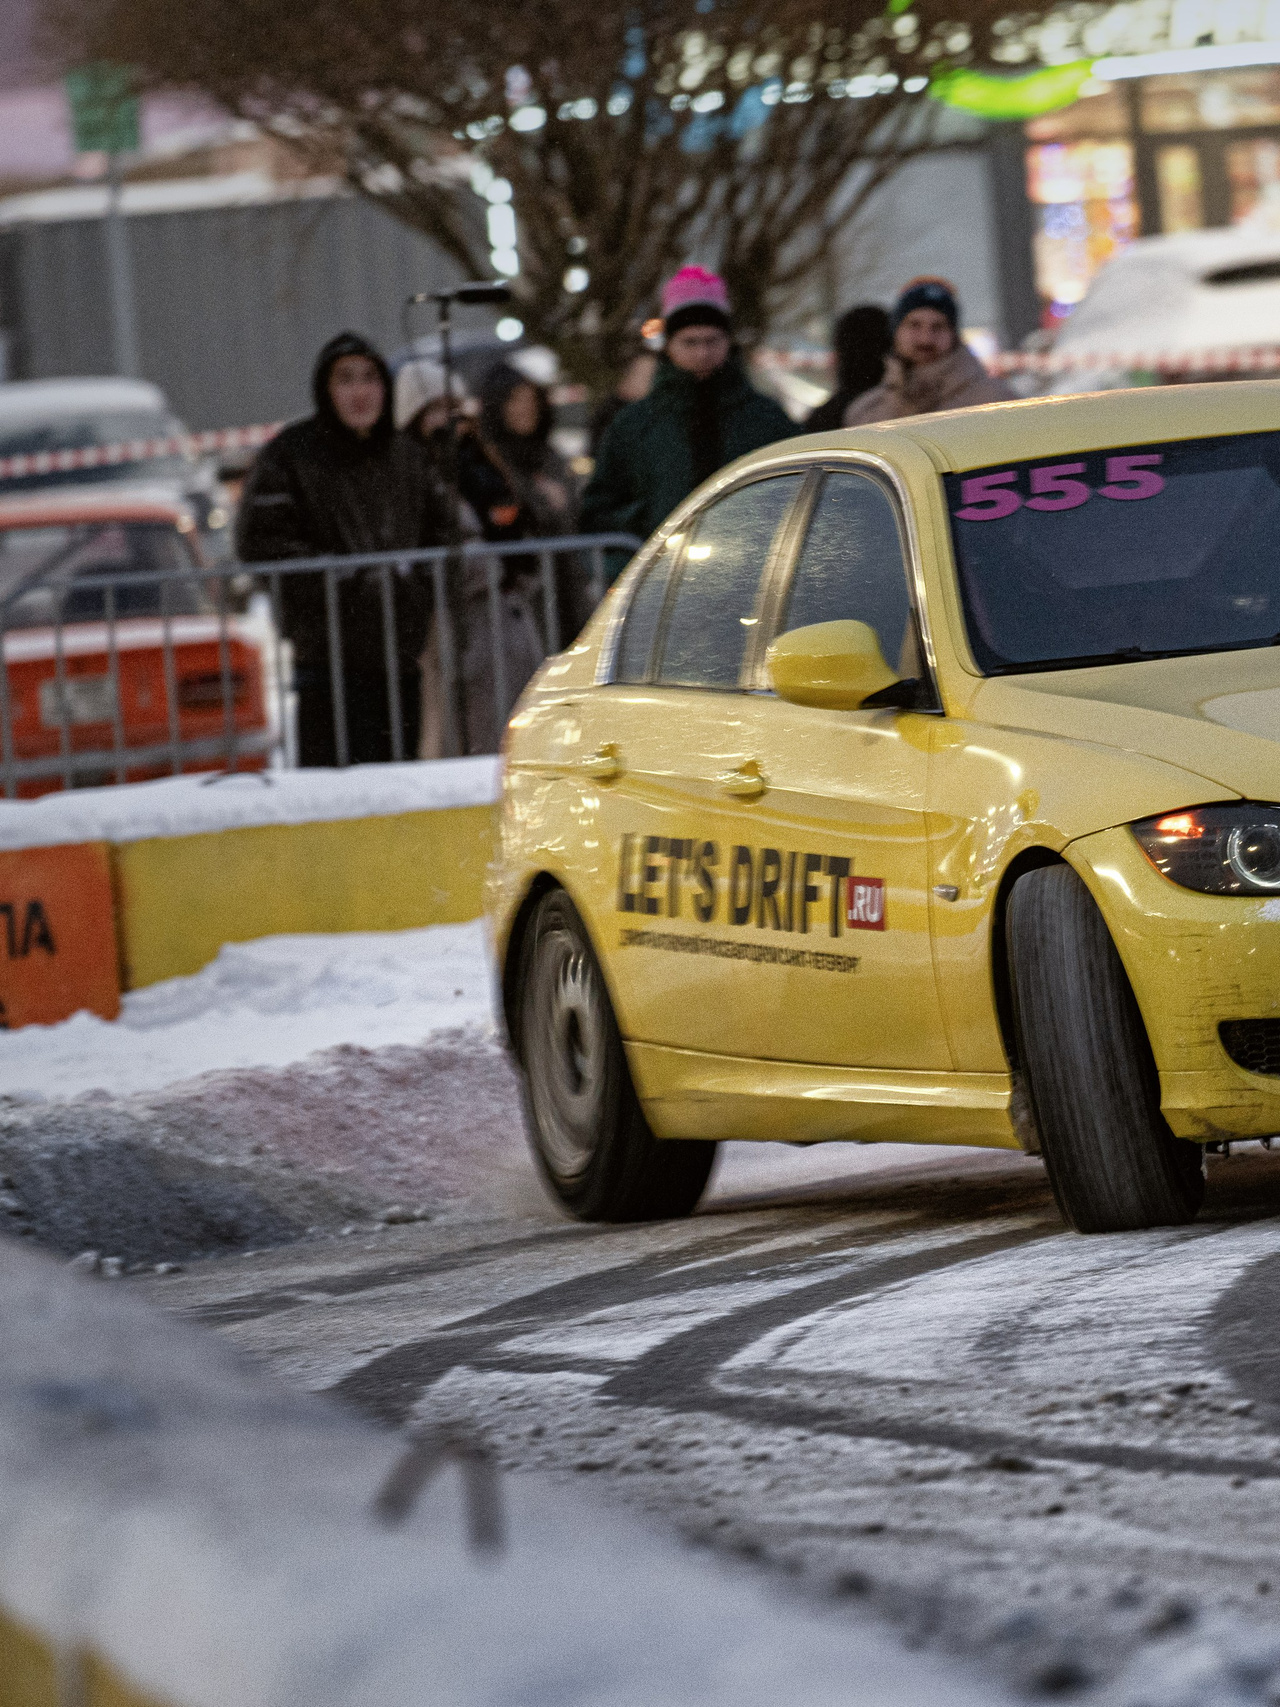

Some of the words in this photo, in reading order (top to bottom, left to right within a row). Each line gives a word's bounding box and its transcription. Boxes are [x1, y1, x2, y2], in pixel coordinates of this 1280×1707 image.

[954, 454, 1164, 521] 555
[617, 833, 719, 923] LET'S
[729, 845, 852, 938] DRIFT
